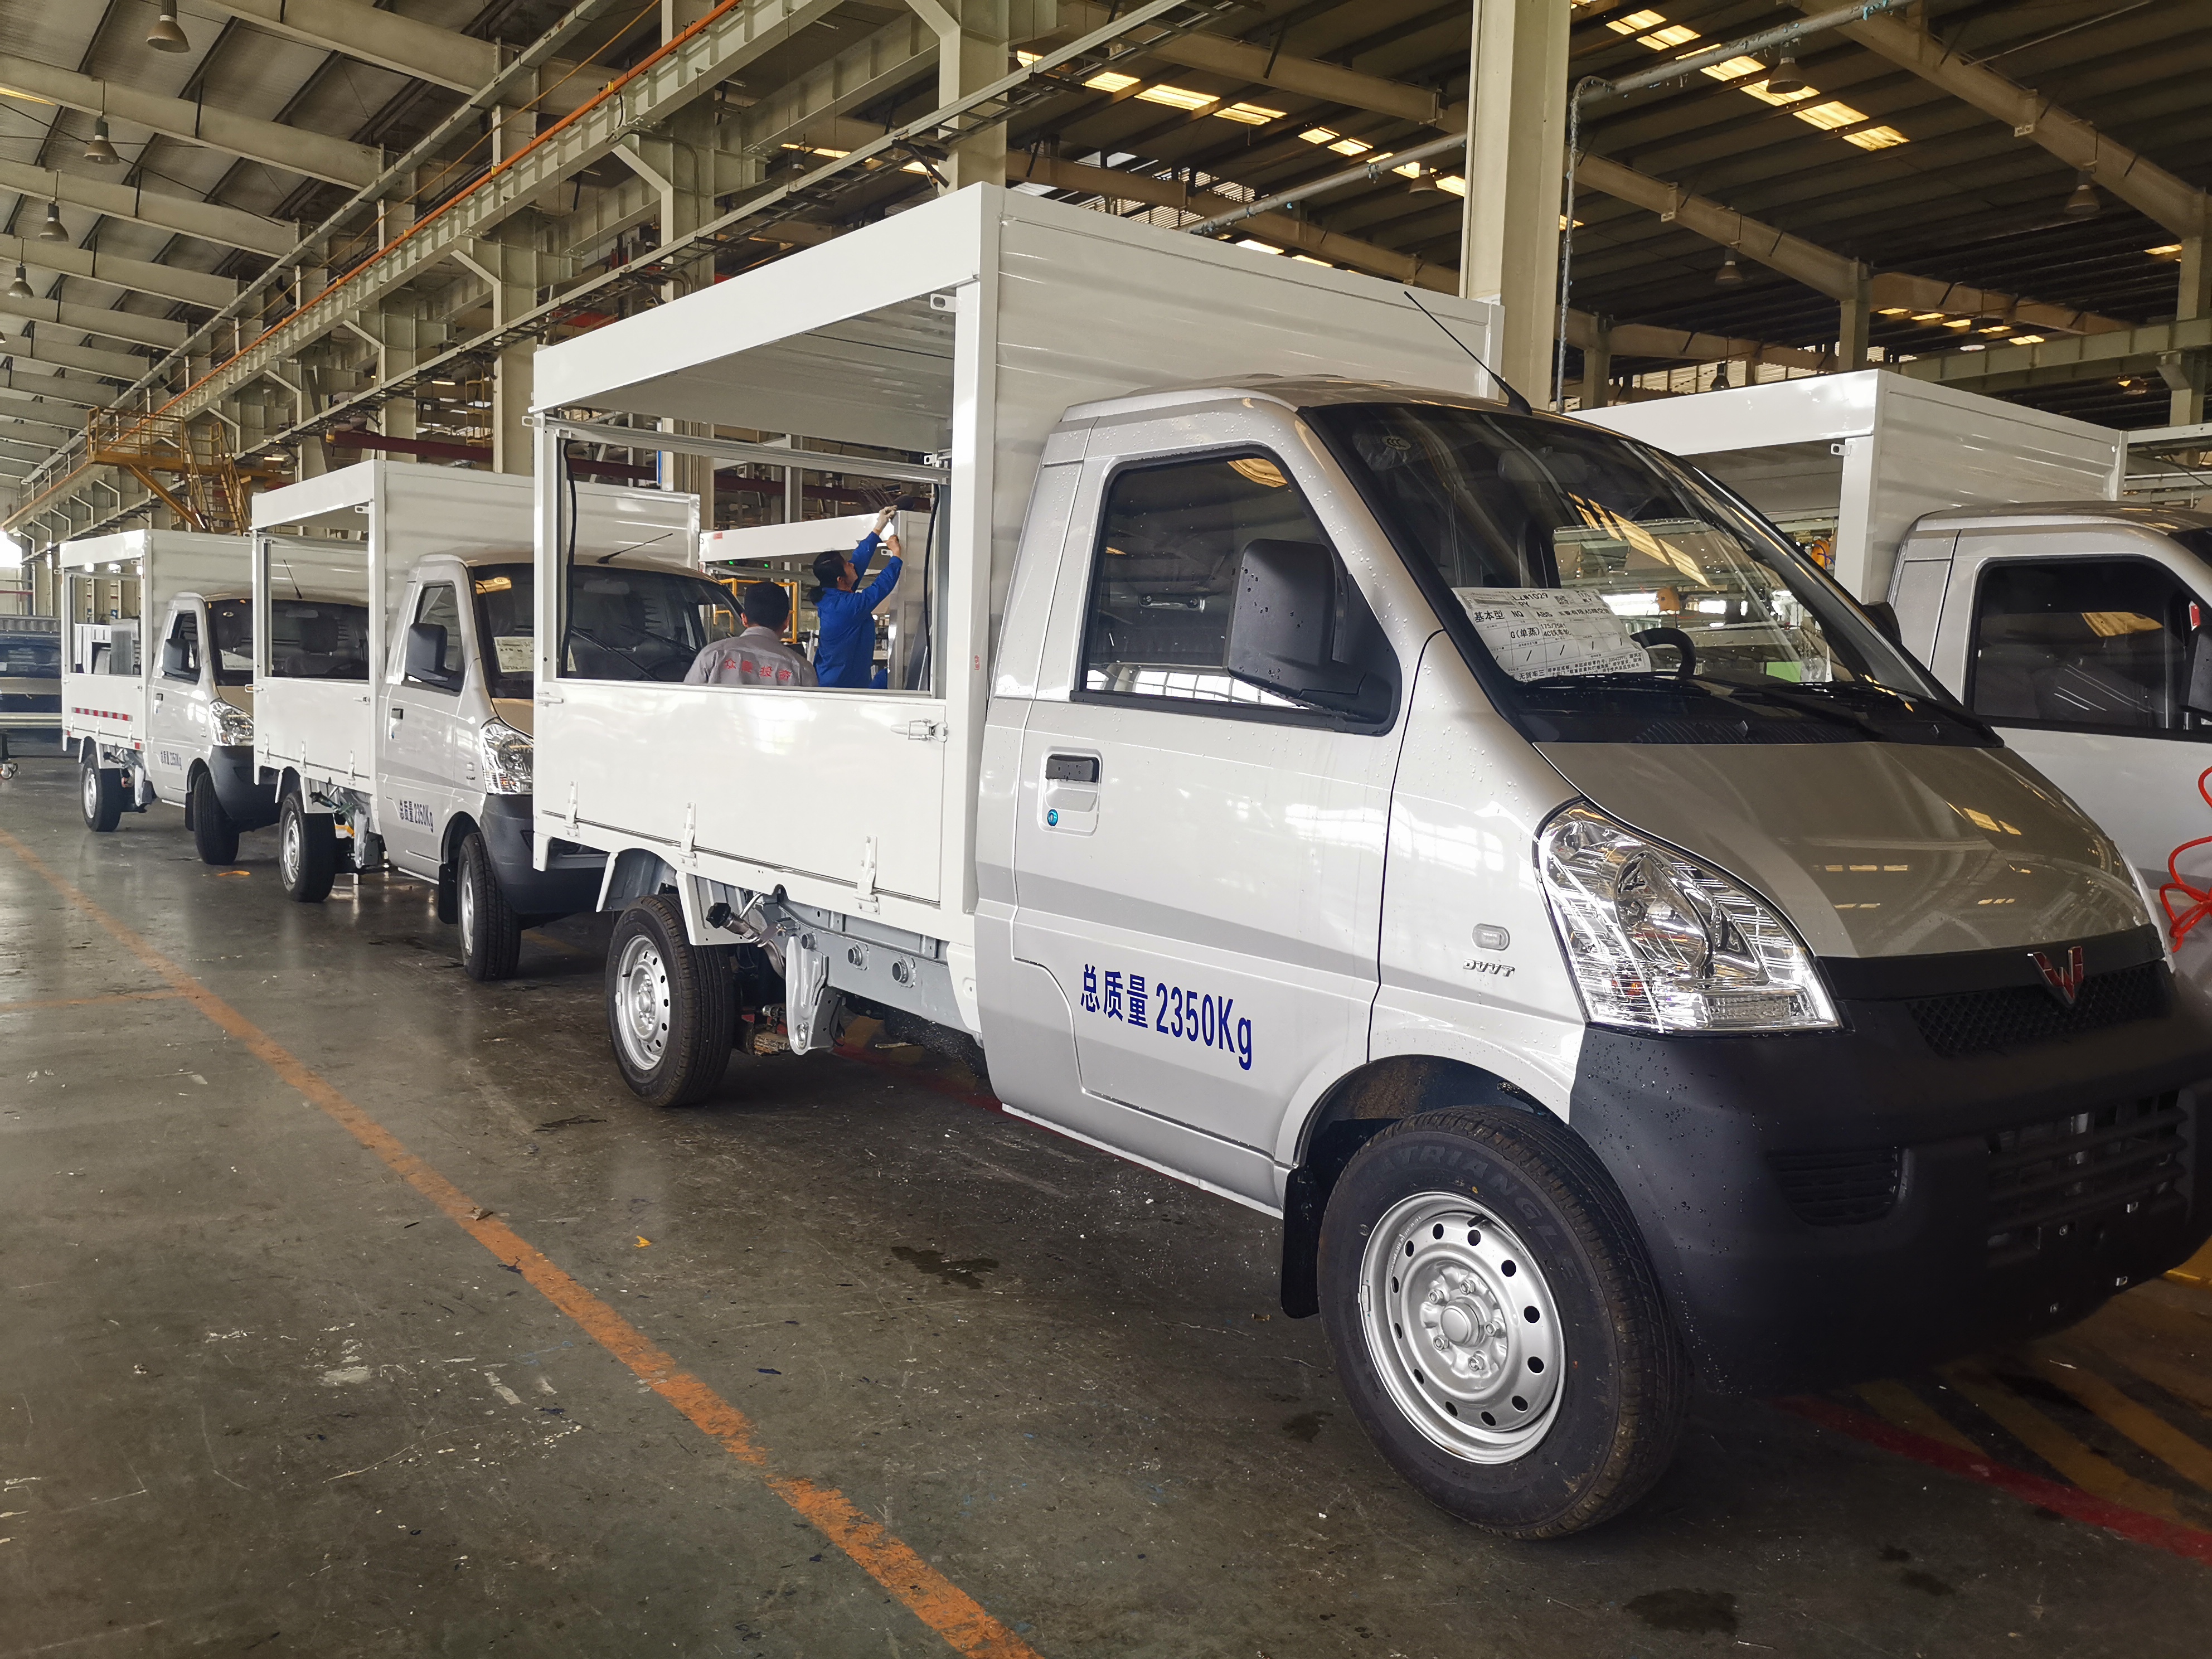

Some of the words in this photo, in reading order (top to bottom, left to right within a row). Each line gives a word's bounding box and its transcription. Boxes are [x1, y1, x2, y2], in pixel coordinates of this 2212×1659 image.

[1474, 610, 1505, 623] 基本型
[1462, 958, 1515, 977] DVVT
[1080, 963, 1148, 1029] 总质量
[1156, 982, 1252, 1071] 2350Kg
